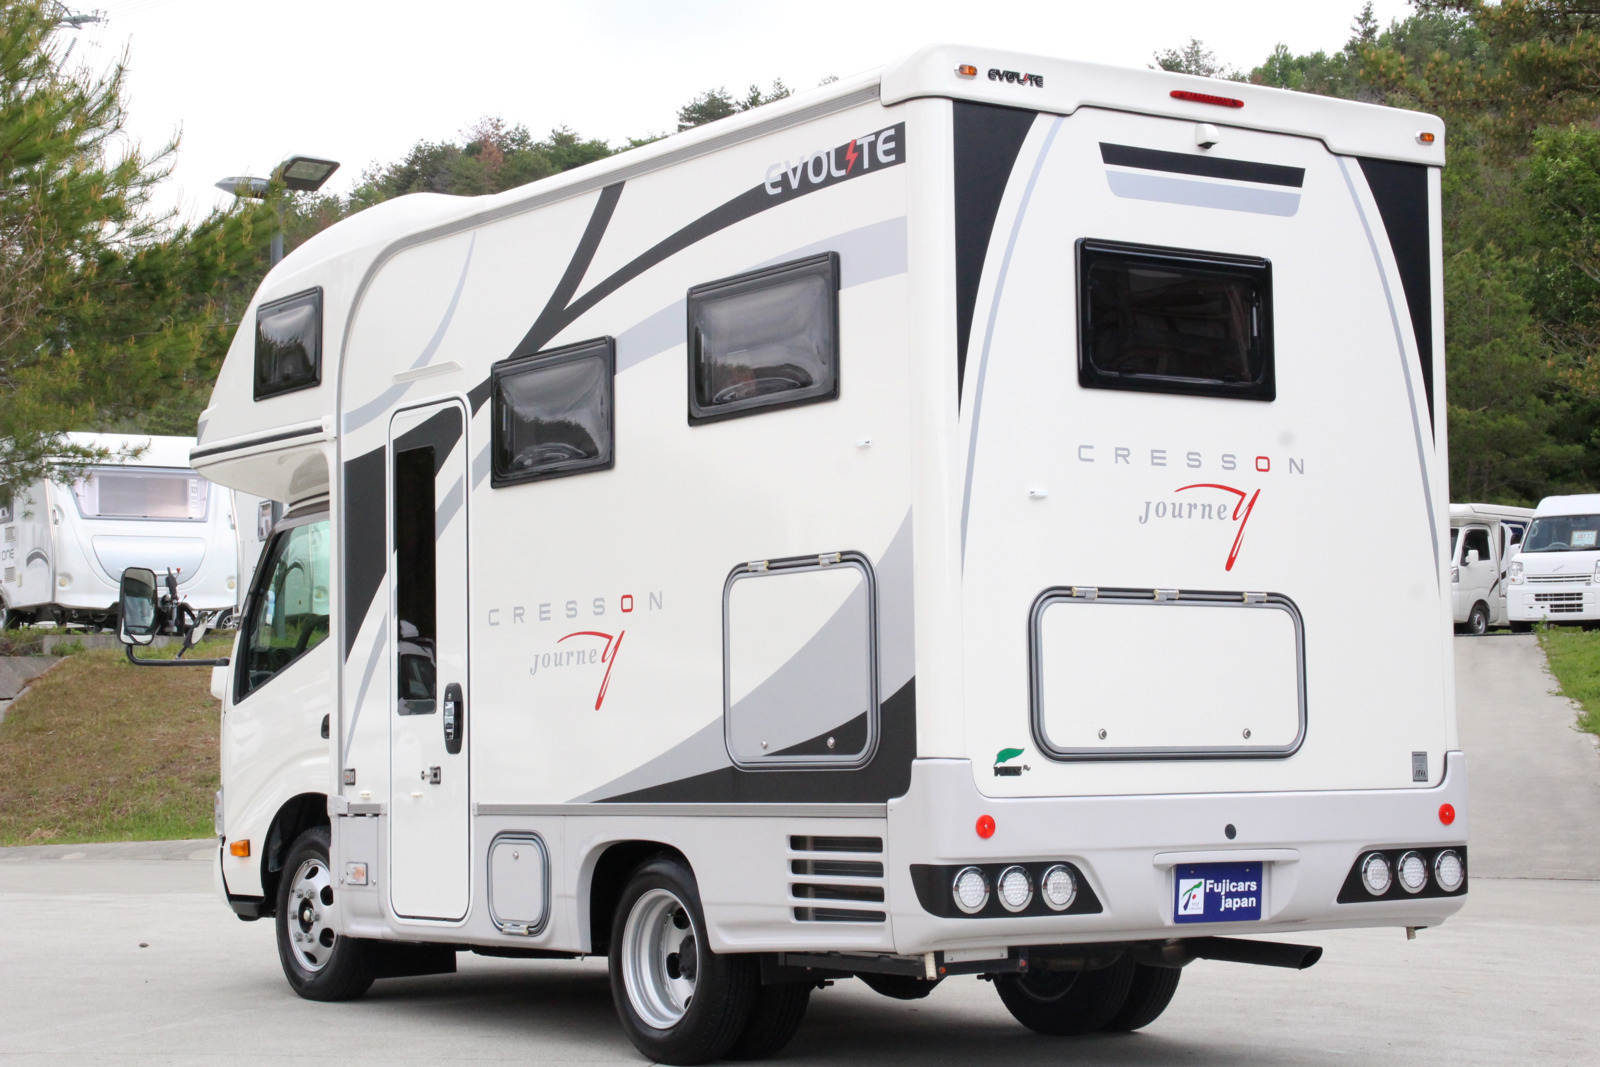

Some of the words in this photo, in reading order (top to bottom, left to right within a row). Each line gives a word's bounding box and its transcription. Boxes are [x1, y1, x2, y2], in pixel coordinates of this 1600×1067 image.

[1078, 444, 1304, 475] CRESSON
[488, 591, 663, 627] CRESSON
[1205, 879, 1257, 895] Fujicars
[1219, 895, 1257, 912] japan
